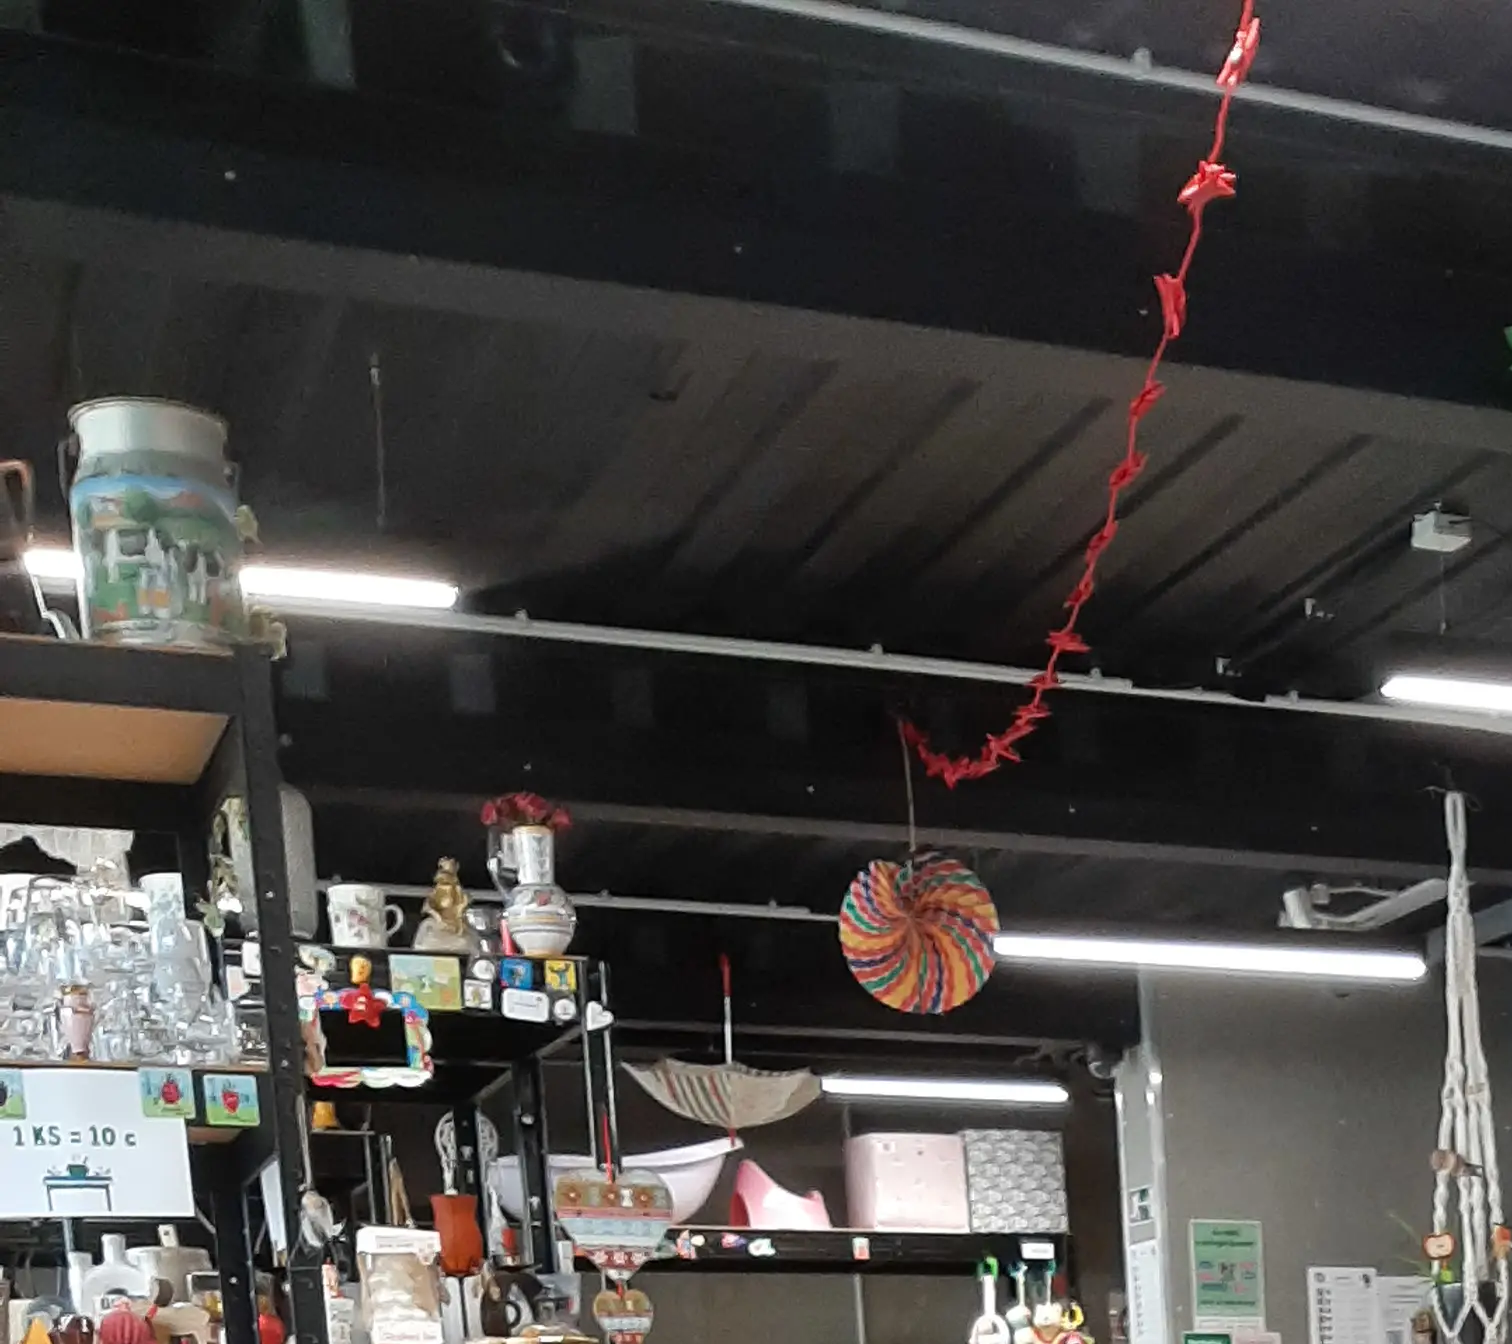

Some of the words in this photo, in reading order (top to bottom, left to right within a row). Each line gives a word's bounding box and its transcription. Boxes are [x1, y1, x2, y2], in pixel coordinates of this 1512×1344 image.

[12, 1125, 25, 1147] 1
[32, 1125, 62, 1147] KS
[69, 1130, 82, 1144] =
[88, 1124, 117, 1147] 10
